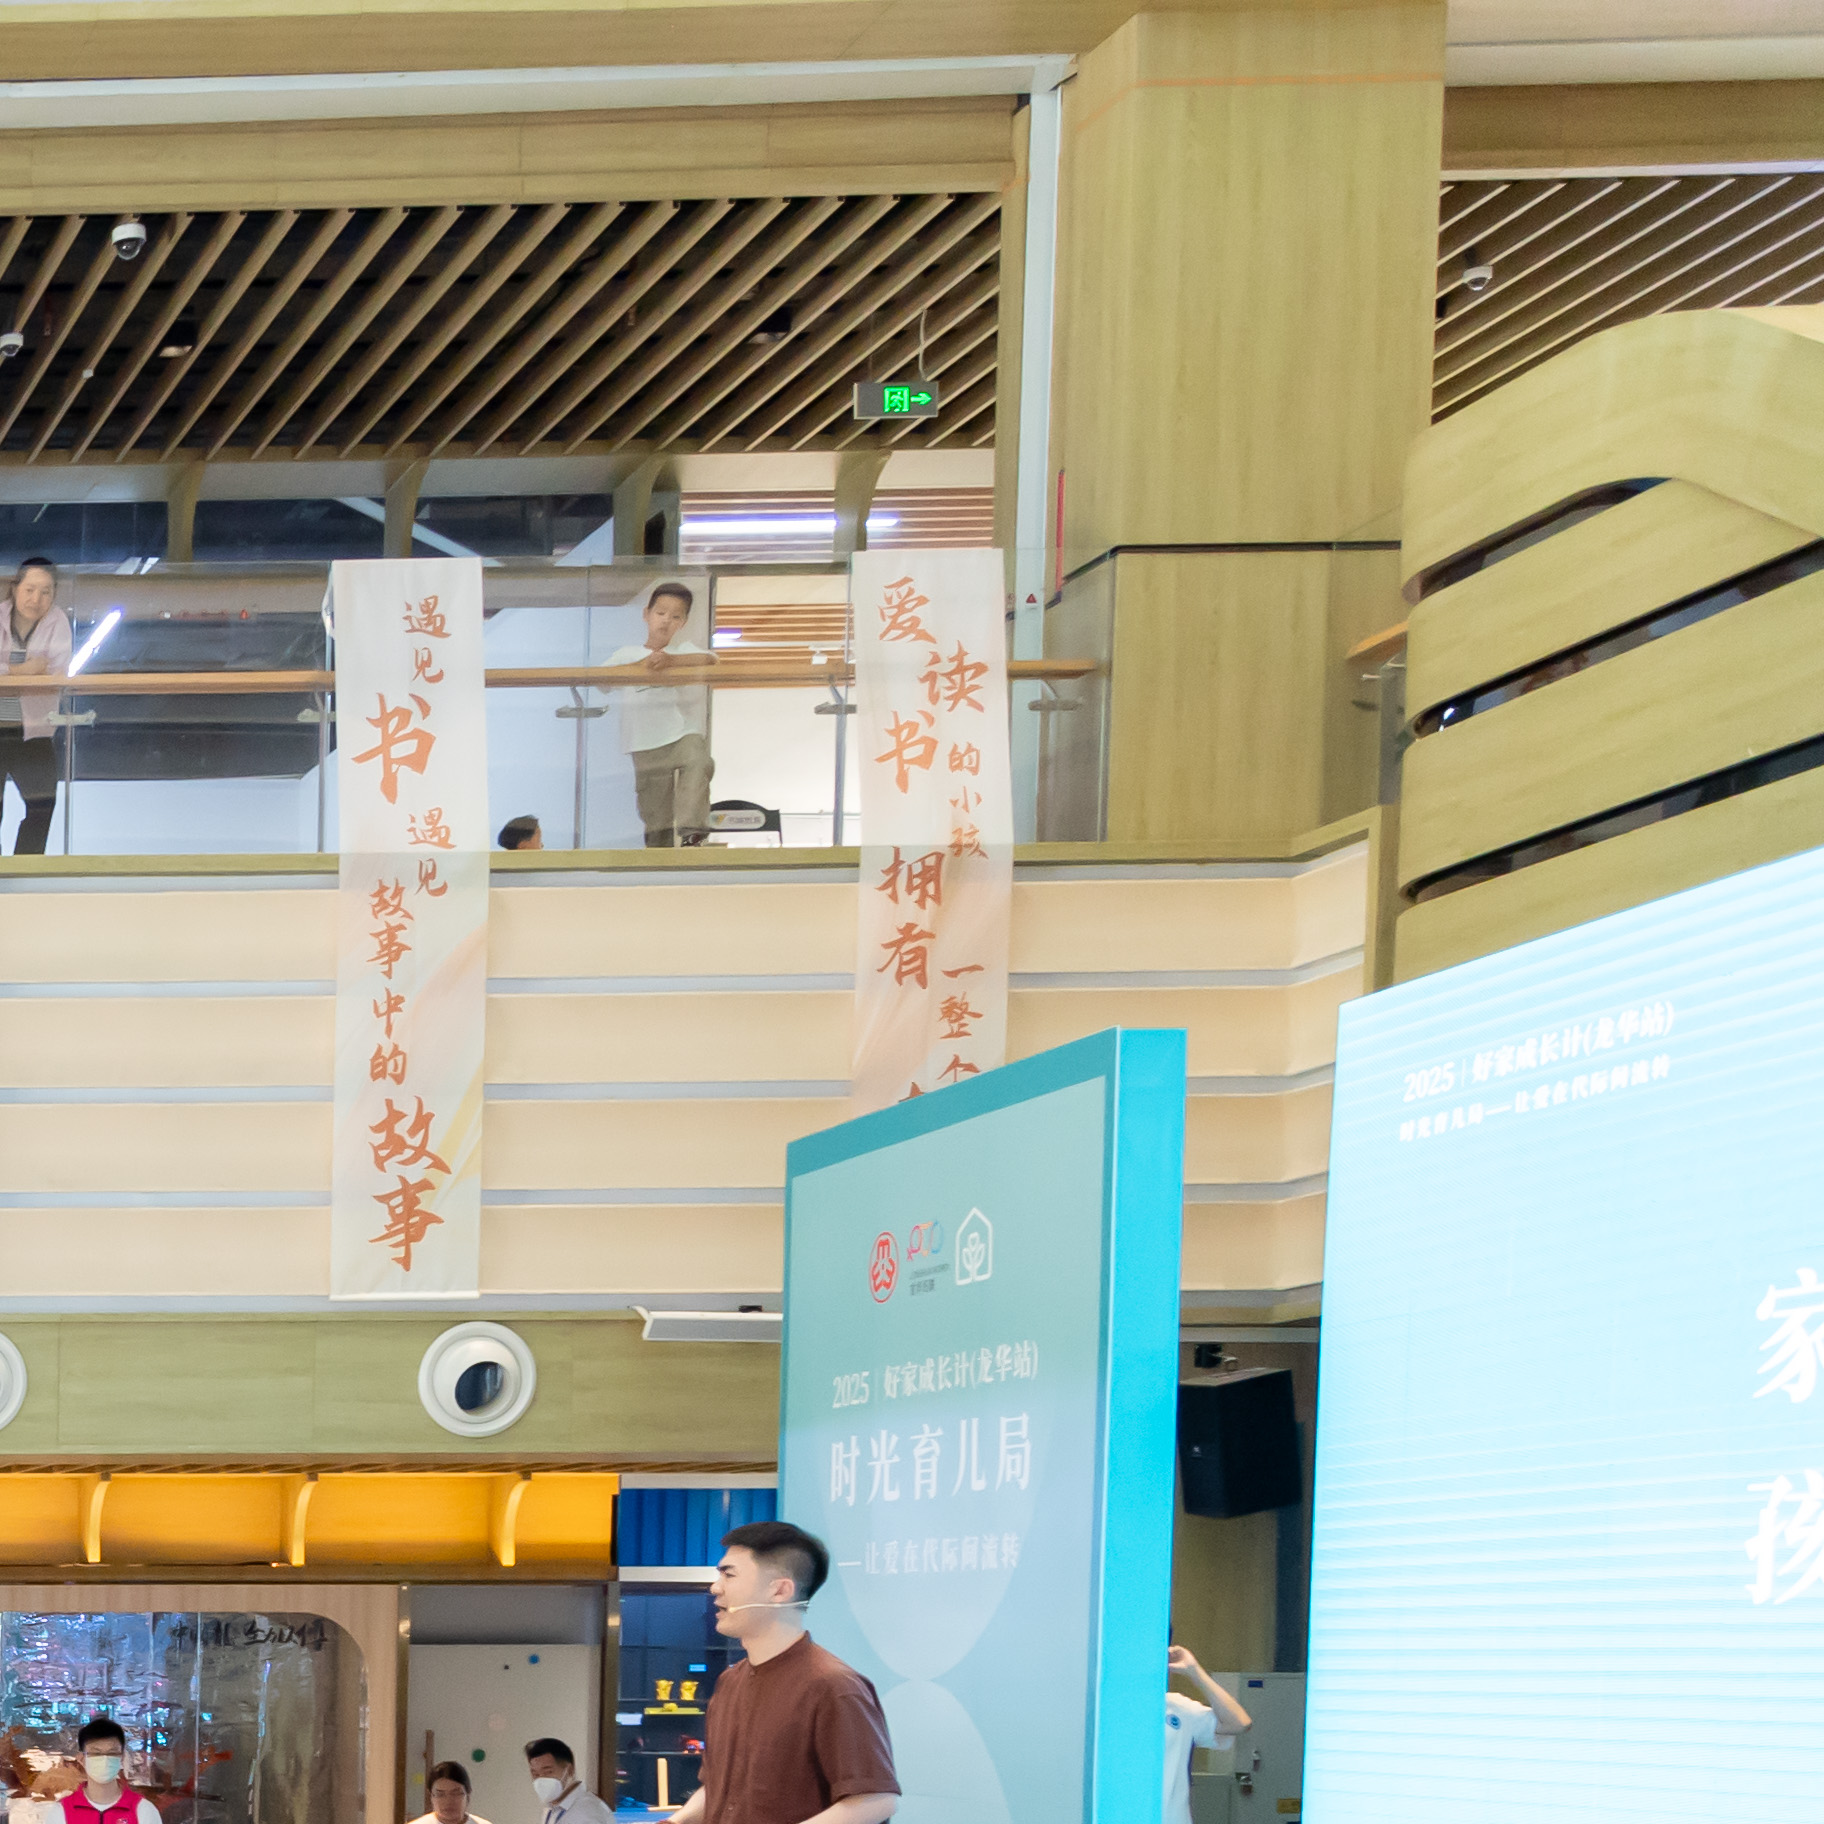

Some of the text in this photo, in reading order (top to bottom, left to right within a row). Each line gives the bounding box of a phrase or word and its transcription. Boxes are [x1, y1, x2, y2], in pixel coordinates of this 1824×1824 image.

[1403, 1061, 1455, 1103] 2025
[833, 1371, 869, 1408] 2025
[829, 1413, 1032, 1505] 时光育儿局
